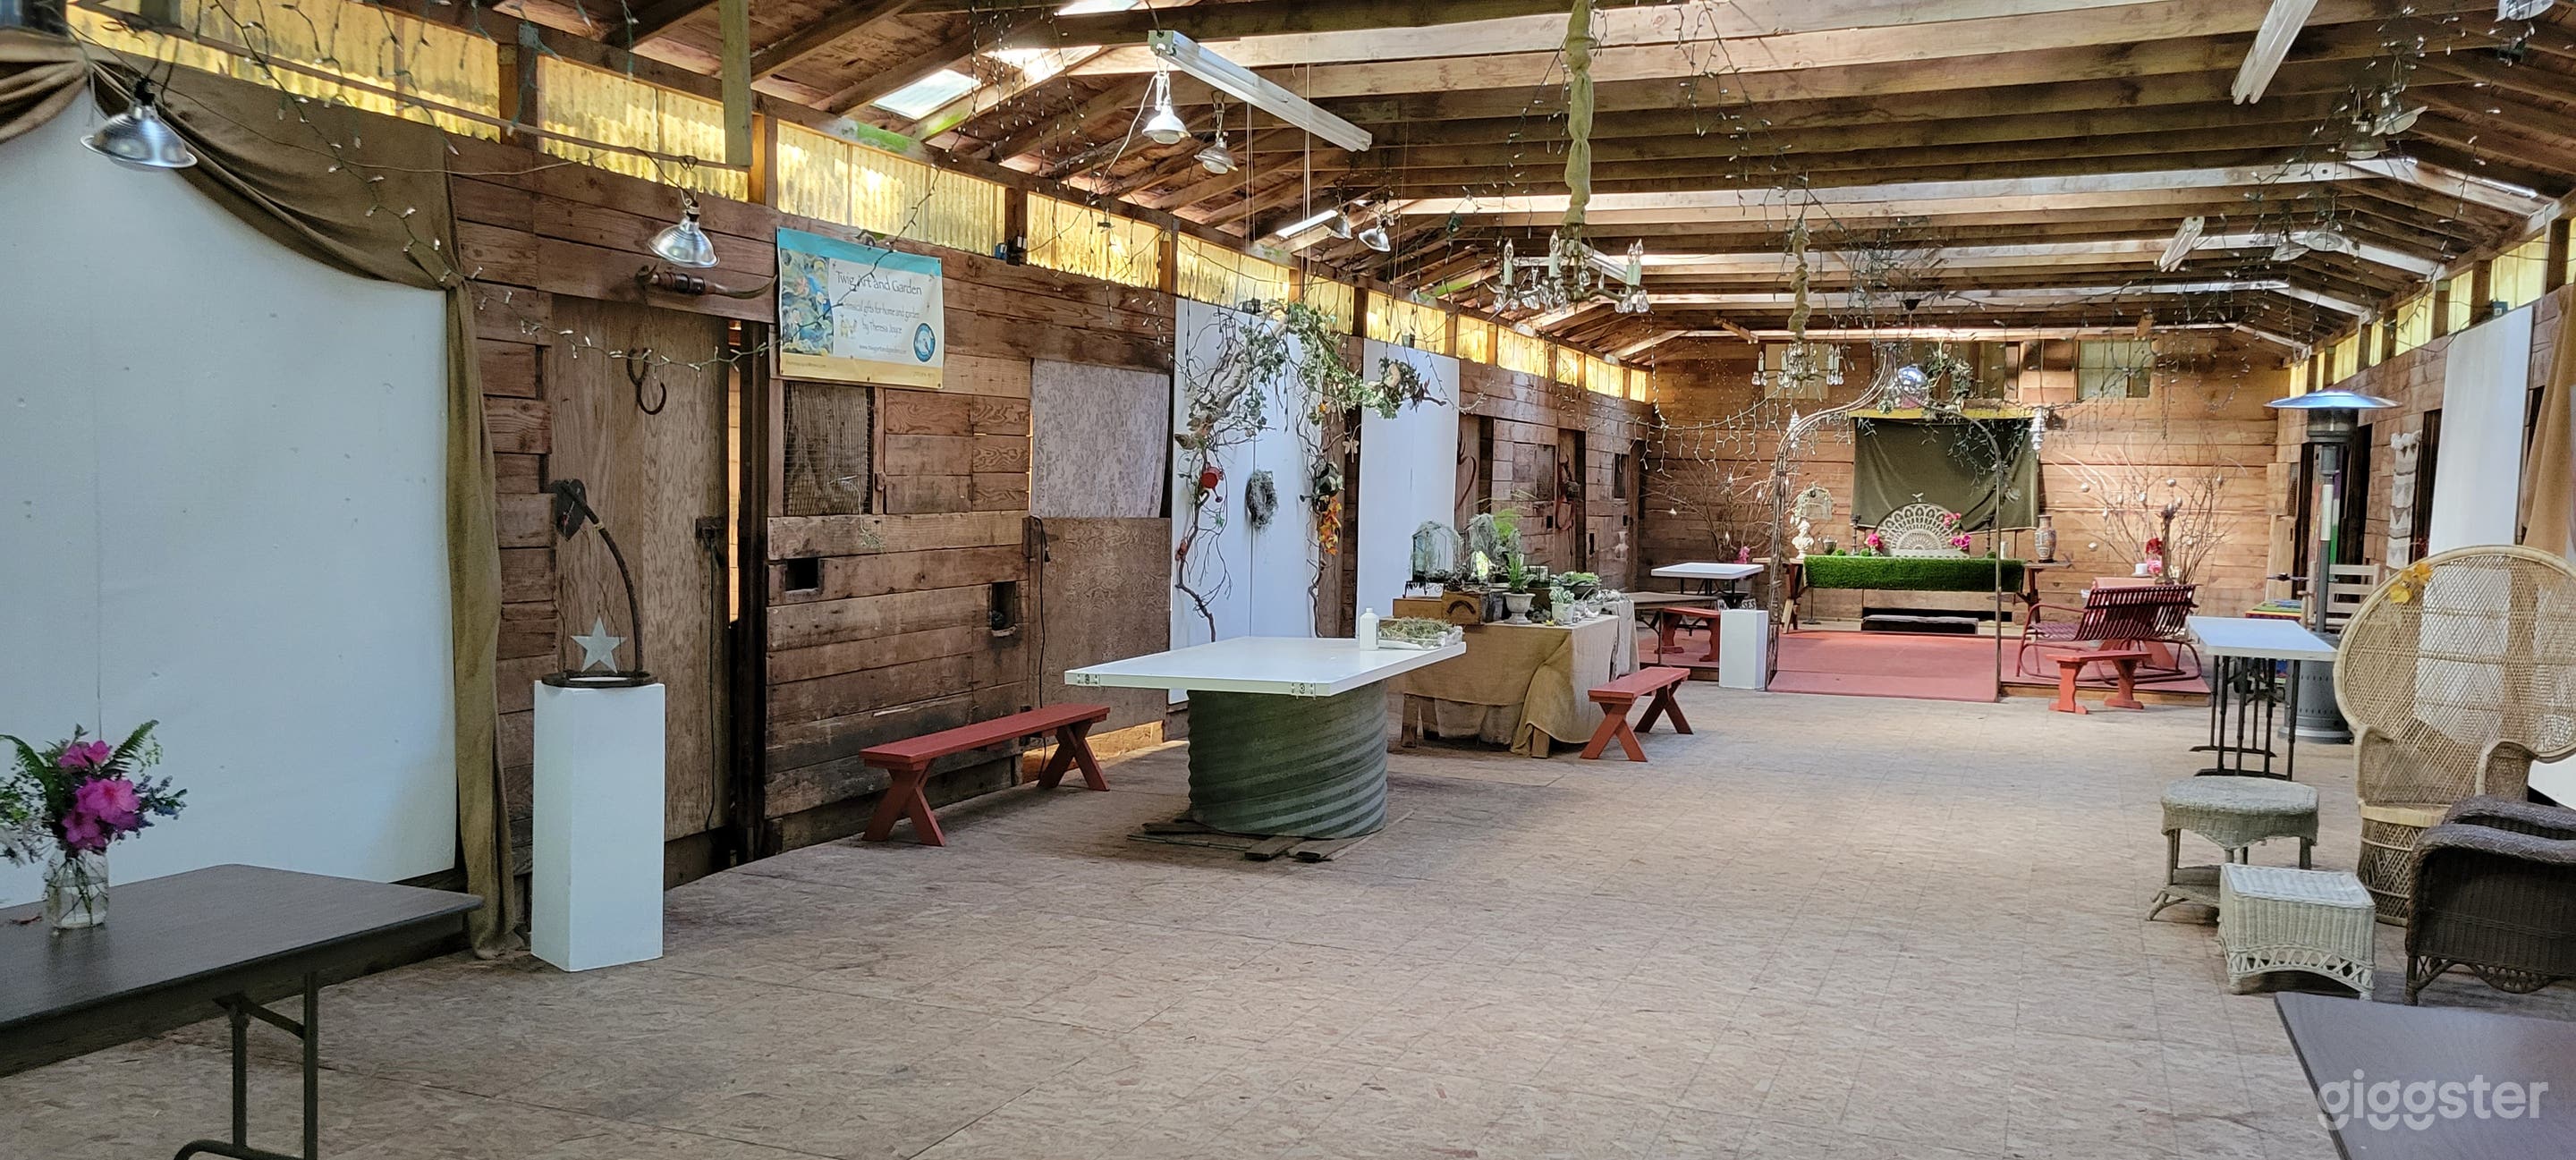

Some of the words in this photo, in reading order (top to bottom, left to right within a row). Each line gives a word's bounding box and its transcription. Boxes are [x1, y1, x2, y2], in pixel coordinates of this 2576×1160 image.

[836, 271, 854, 287] Twig
[857, 275, 872, 287] Art
[874, 275, 890, 291] and
[892, 278, 922, 295] Garden
